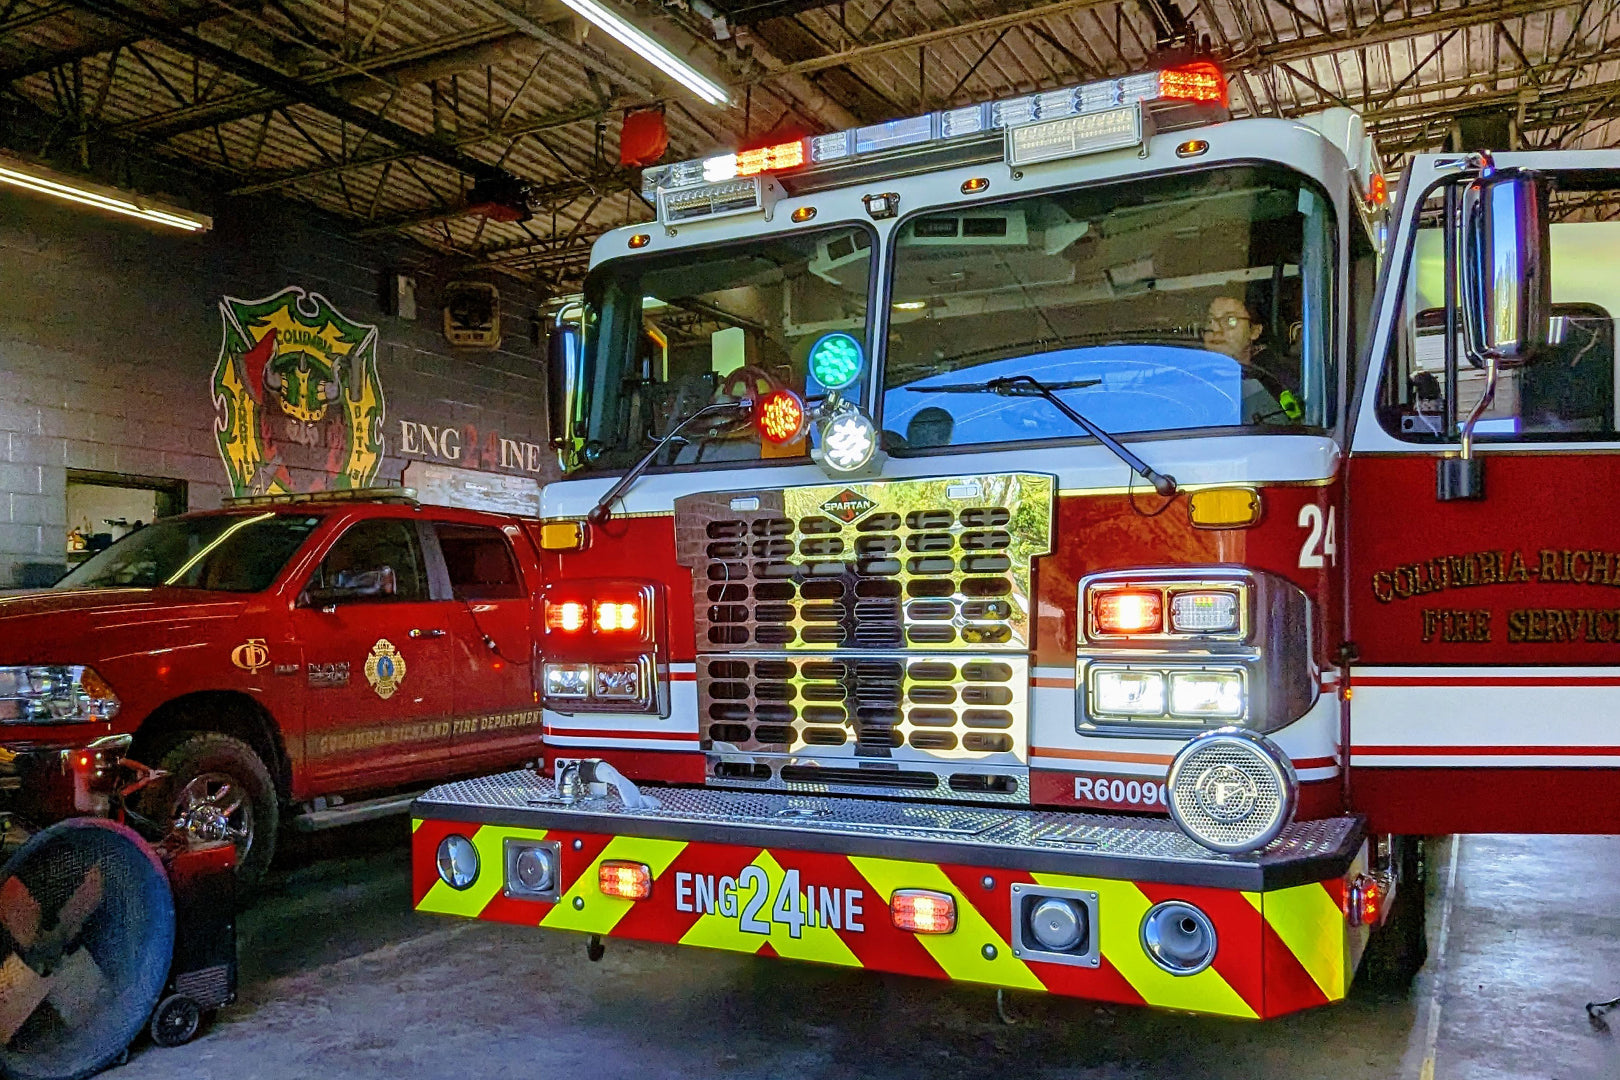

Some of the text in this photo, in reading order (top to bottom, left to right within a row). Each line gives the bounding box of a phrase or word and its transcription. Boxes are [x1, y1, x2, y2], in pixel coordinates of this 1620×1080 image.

[824, 500, 870, 511] SPARTAN
[1298, 503, 1337, 569] 24
[1372, 549, 1620, 602] COLUMBIA-RICH
[1421, 608, 1620, 642] FIRE SERVIC
[453, 719, 478, 735] FIRE
